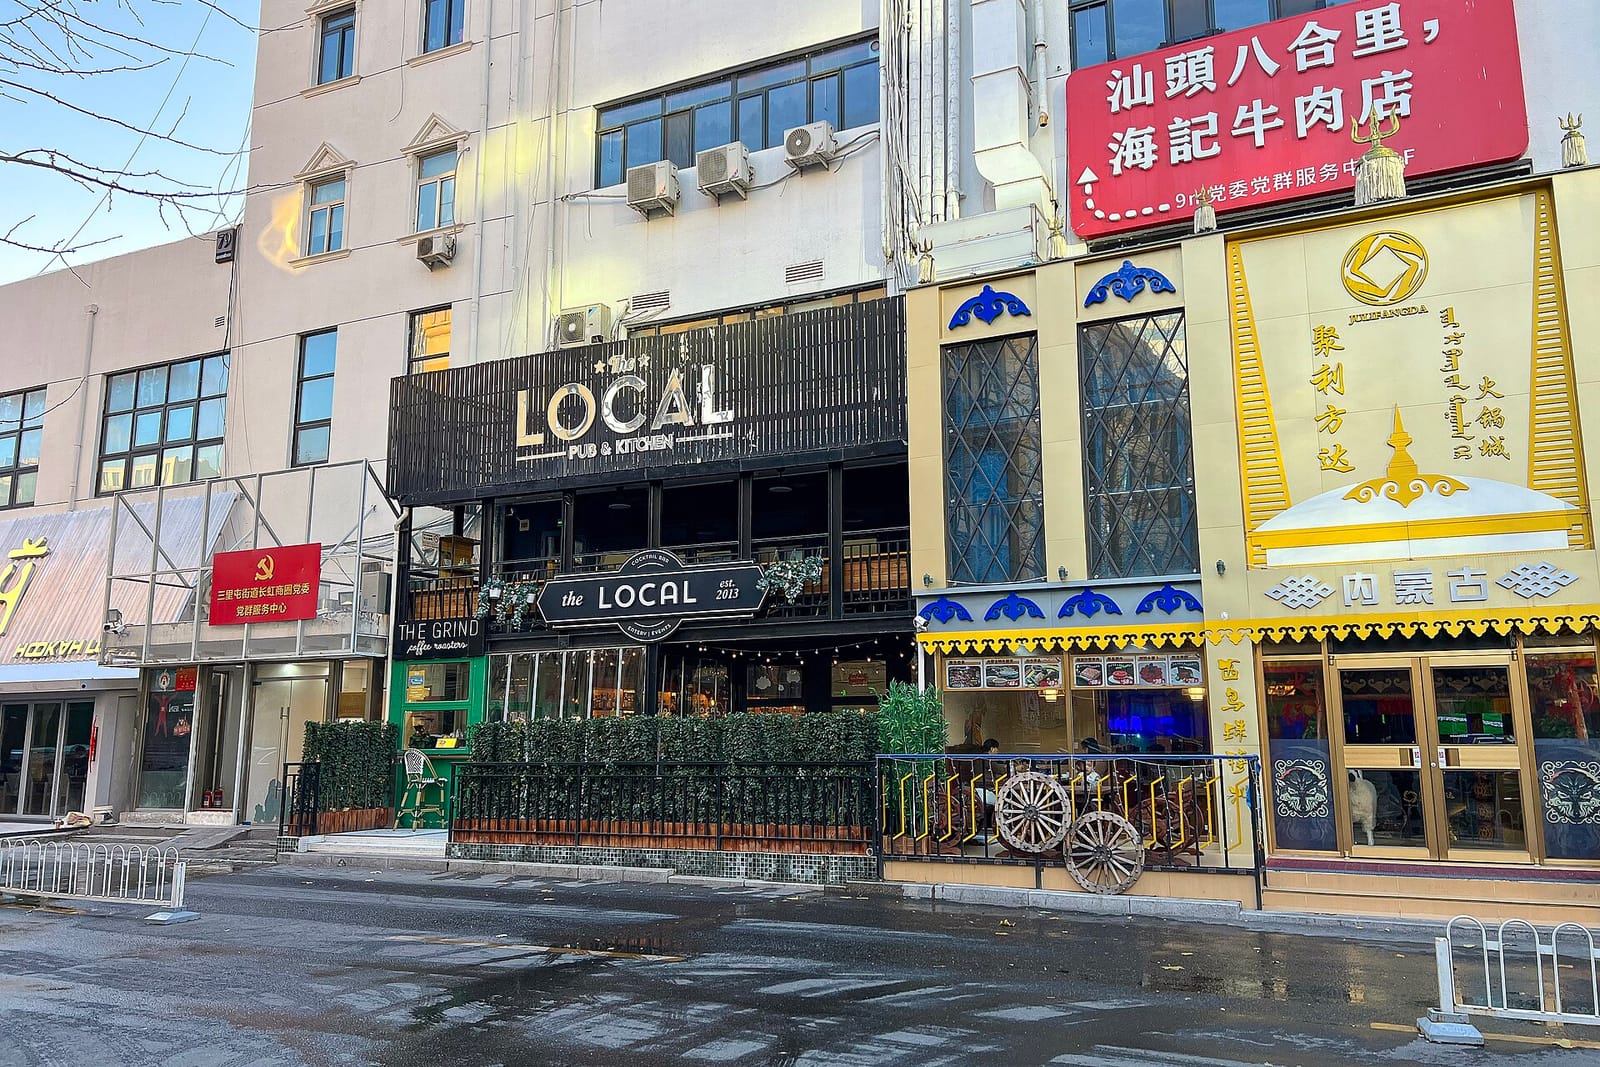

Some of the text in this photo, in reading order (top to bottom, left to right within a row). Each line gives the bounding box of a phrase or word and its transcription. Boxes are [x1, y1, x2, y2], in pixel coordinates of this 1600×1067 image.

[1107, 69, 1414, 177] 海記牛肉店
[1348, 304, 1429, 326] JULIFANGDA
[608, 353, 636, 374] The
[516, 363, 735, 448] LOCAL
[1310, 324, 1356, 473] 聚利方达
[1475, 376, 1511, 461] 火锅城
[569, 433, 674, 460] PUB & KITCHEN
[631, 554, 658, 566] COCKTAIL
[217, 582, 310, 601] 三里屯街道长虹商圈党委
[715, 588, 740, 600] 2013
[719, 579, 737, 588] est.
[1342, 566, 1489, 608] 内蒙古
[561, 580, 697, 610] the LOCAL
[236, 602, 287, 617] 党群服务中心
[398, 619, 479, 641] THE GRIND
[12, 639, 84, 658] HOOKAH
[406, 640, 468, 656] coffee roasters
